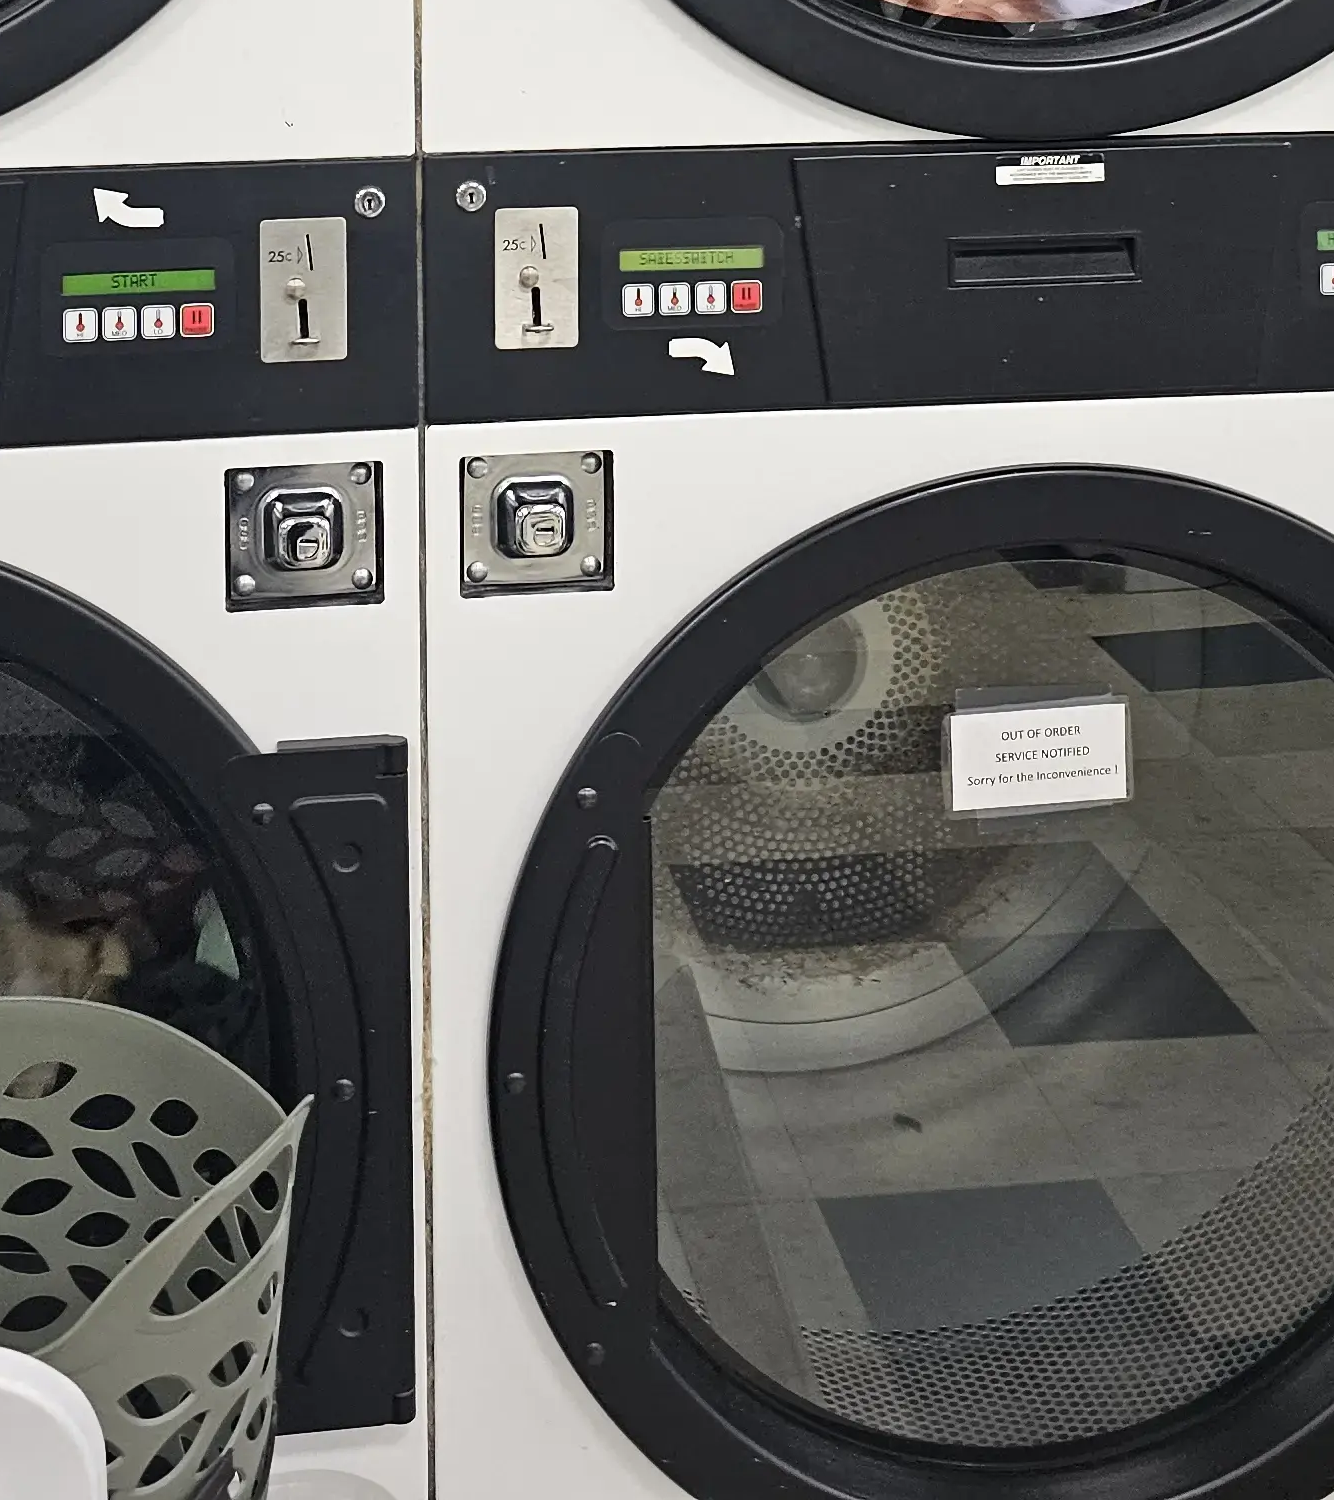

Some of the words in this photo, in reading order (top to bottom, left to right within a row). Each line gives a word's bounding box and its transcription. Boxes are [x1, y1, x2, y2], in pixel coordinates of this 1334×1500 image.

[1020, 154, 1081, 166] IMPORTANT
[110, 273, 158, 288] START
[1001, 729, 1024, 741] OUT
[1027, 728, 1042, 739] OF
[1044, 725, 1081, 738] ORDER
[995, 750, 1038, 763] SERVICE
[1041, 746, 1091, 760] NOTIFIED
[967, 775, 996, 787] Sorry
[998, 773, 1014, 784] for
[1016, 771, 1034, 783] the
[1036, 766, 1112, 781] Inconvenience
